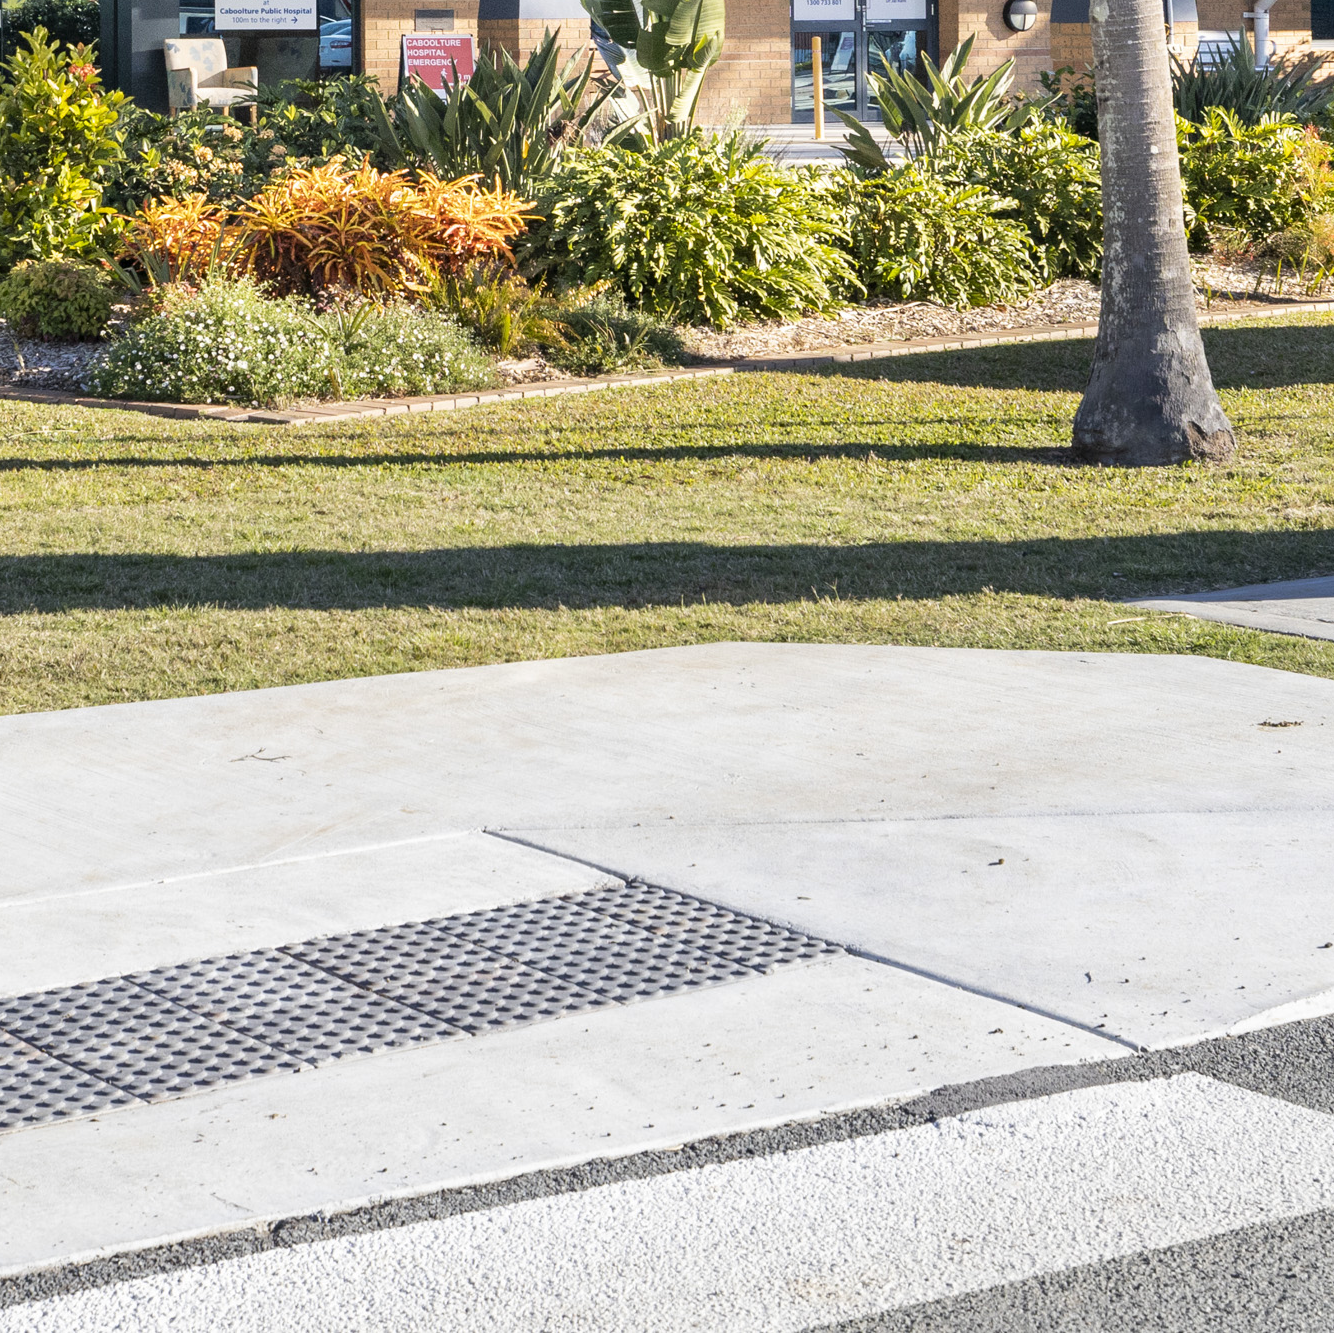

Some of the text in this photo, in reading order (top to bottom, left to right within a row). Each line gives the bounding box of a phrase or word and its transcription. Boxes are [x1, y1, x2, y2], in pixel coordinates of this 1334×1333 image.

[219, 7, 312, 16] Caboolture Public Hospital
[232, 16, 249, 24] 100m
[271, 16, 287, 24] right
